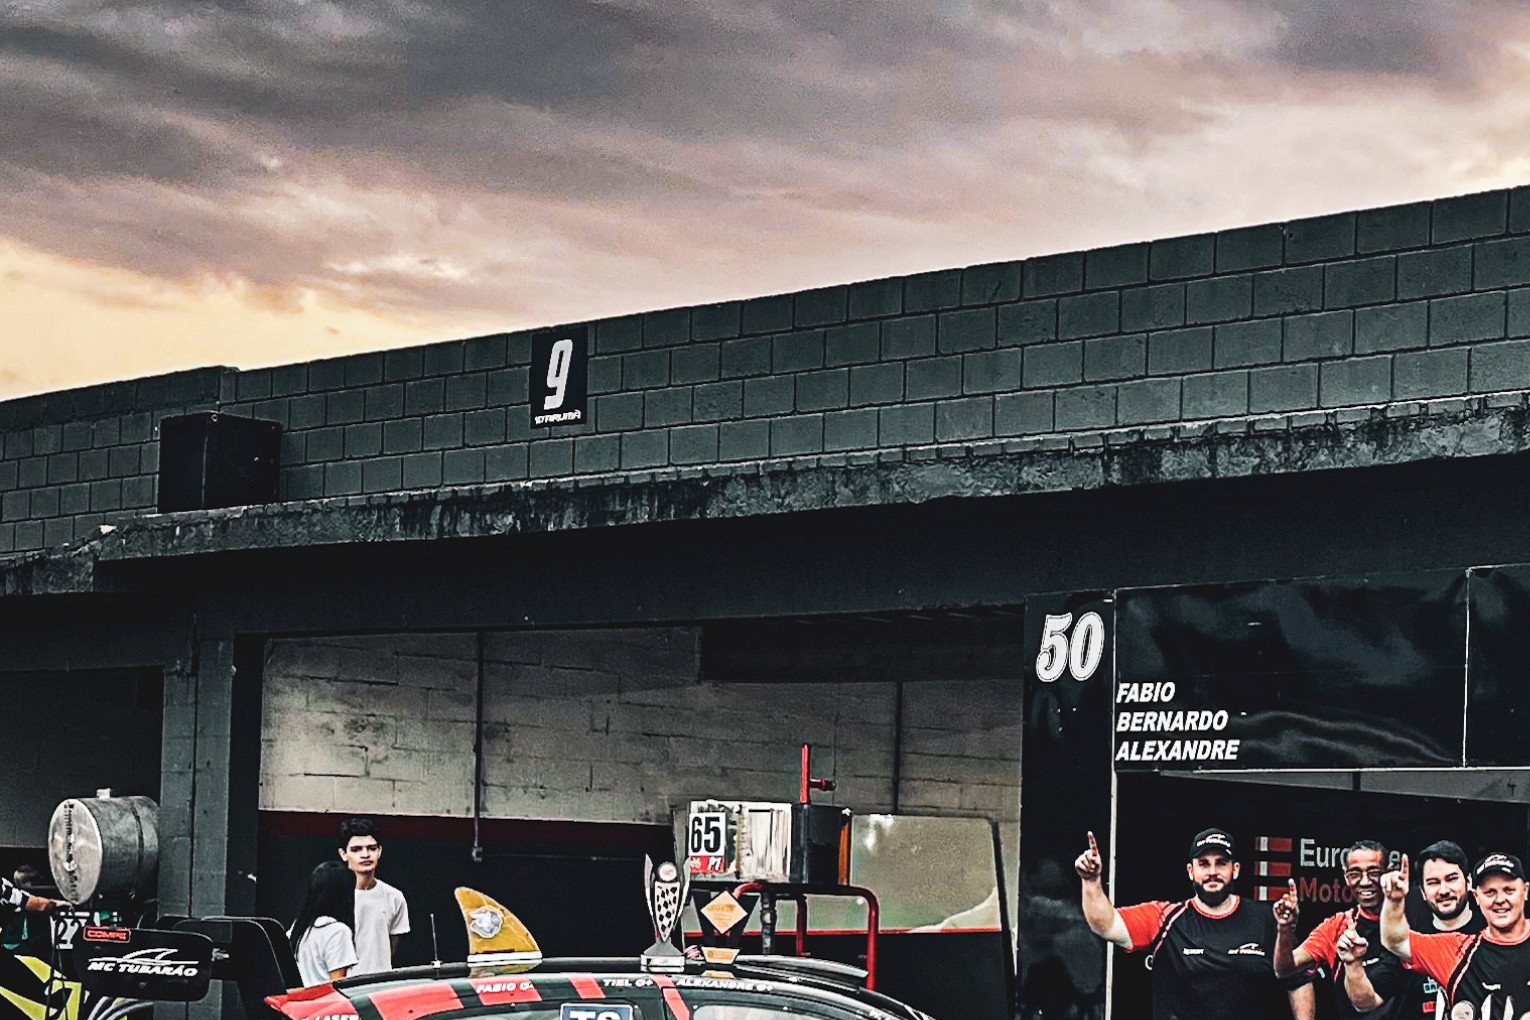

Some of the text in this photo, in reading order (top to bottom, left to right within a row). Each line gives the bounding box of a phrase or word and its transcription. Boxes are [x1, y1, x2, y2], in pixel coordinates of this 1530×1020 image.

[544, 339, 573, 410] 9
[1036, 611, 1104, 682] 50
[1116, 682, 1176, 703] FABIO
[1116, 710, 1229, 732] BERNARDO
[1115, 739, 1240, 761] ALEXANDRE
[691, 816, 721, 853] 65
[87, 961, 198, 977] MC TUBARÃO
[476, 982, 517, 994] FABIO
[604, 978, 631, 988] TIEL
[676, 978, 754, 990] ALEXANDRE
